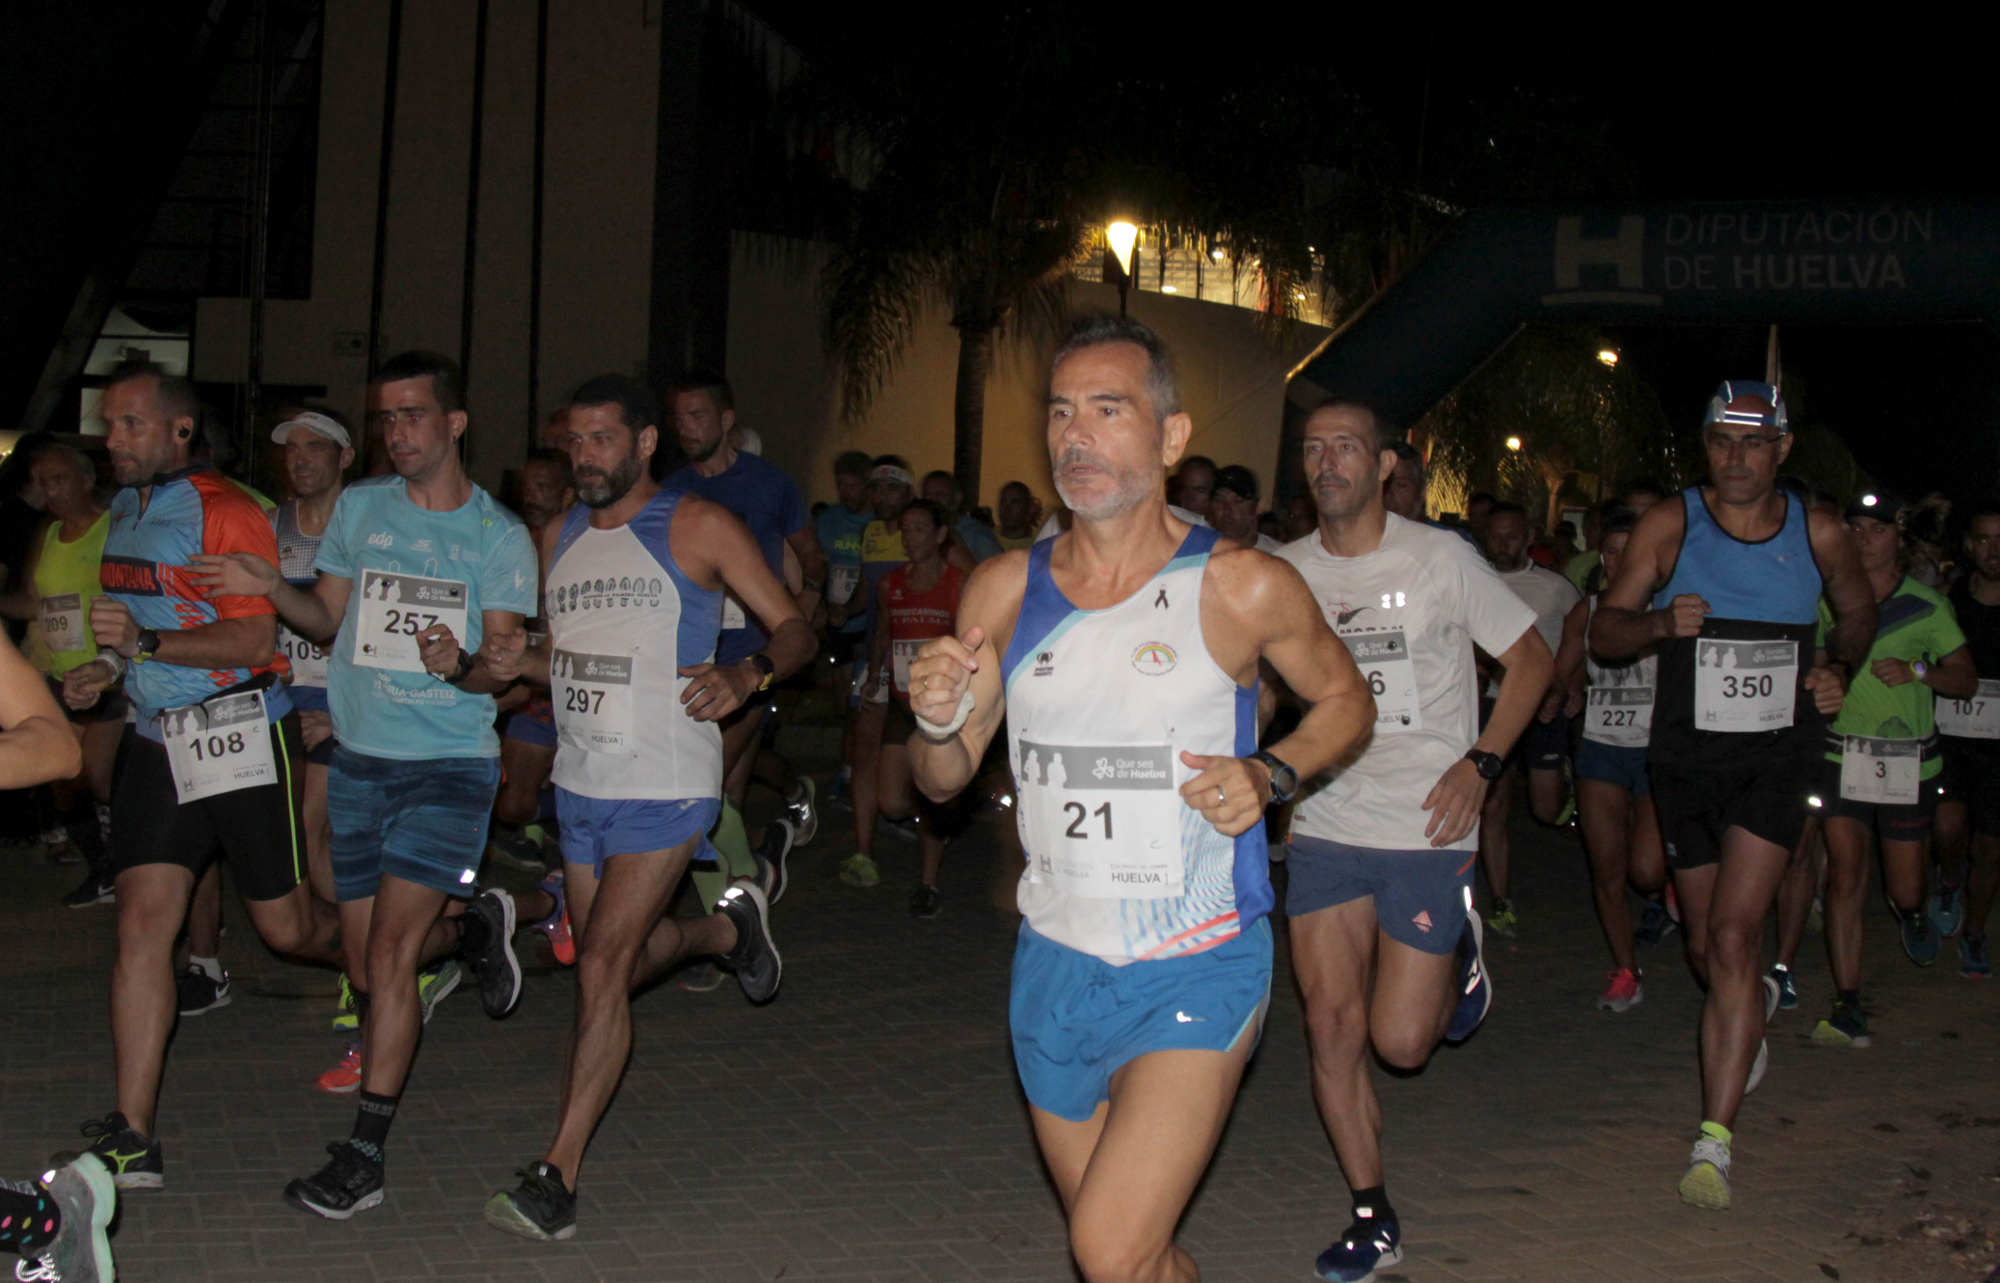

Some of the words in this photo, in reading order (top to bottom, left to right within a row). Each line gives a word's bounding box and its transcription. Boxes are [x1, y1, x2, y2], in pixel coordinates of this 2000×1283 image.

[1663, 203, 1932, 245] DIPUTACIÓN
[1663, 254, 1717, 290] DE
[1732, 253, 1907, 290] HUELVA
[367, 531, 394, 549] edp
[45, 616, 68, 633] 209
[384, 609, 438, 636] 257
[285, 640, 323, 660] 109
[1722, 674, 1773, 698] 350
[566, 686, 606, 715] 297
[1953, 699, 1986, 716] 107
[1602, 710, 1637, 726] 227
[1759, 713, 1784, 722] HUELVA
[189, 732, 245, 761] 108
[591, 735, 618, 744] HUELVA
[1116, 758, 1136, 770] Que
[1137, 760, 1153, 769] sea
[1875, 761, 1886, 778] 3
[234, 770, 265, 780] HUELVA
[1116, 768, 1129, 779] de
[1130, 768, 1166, 779] Huelva
[1062, 801, 1113, 840] 21
[1111, 872, 1161, 884] HUELVA
